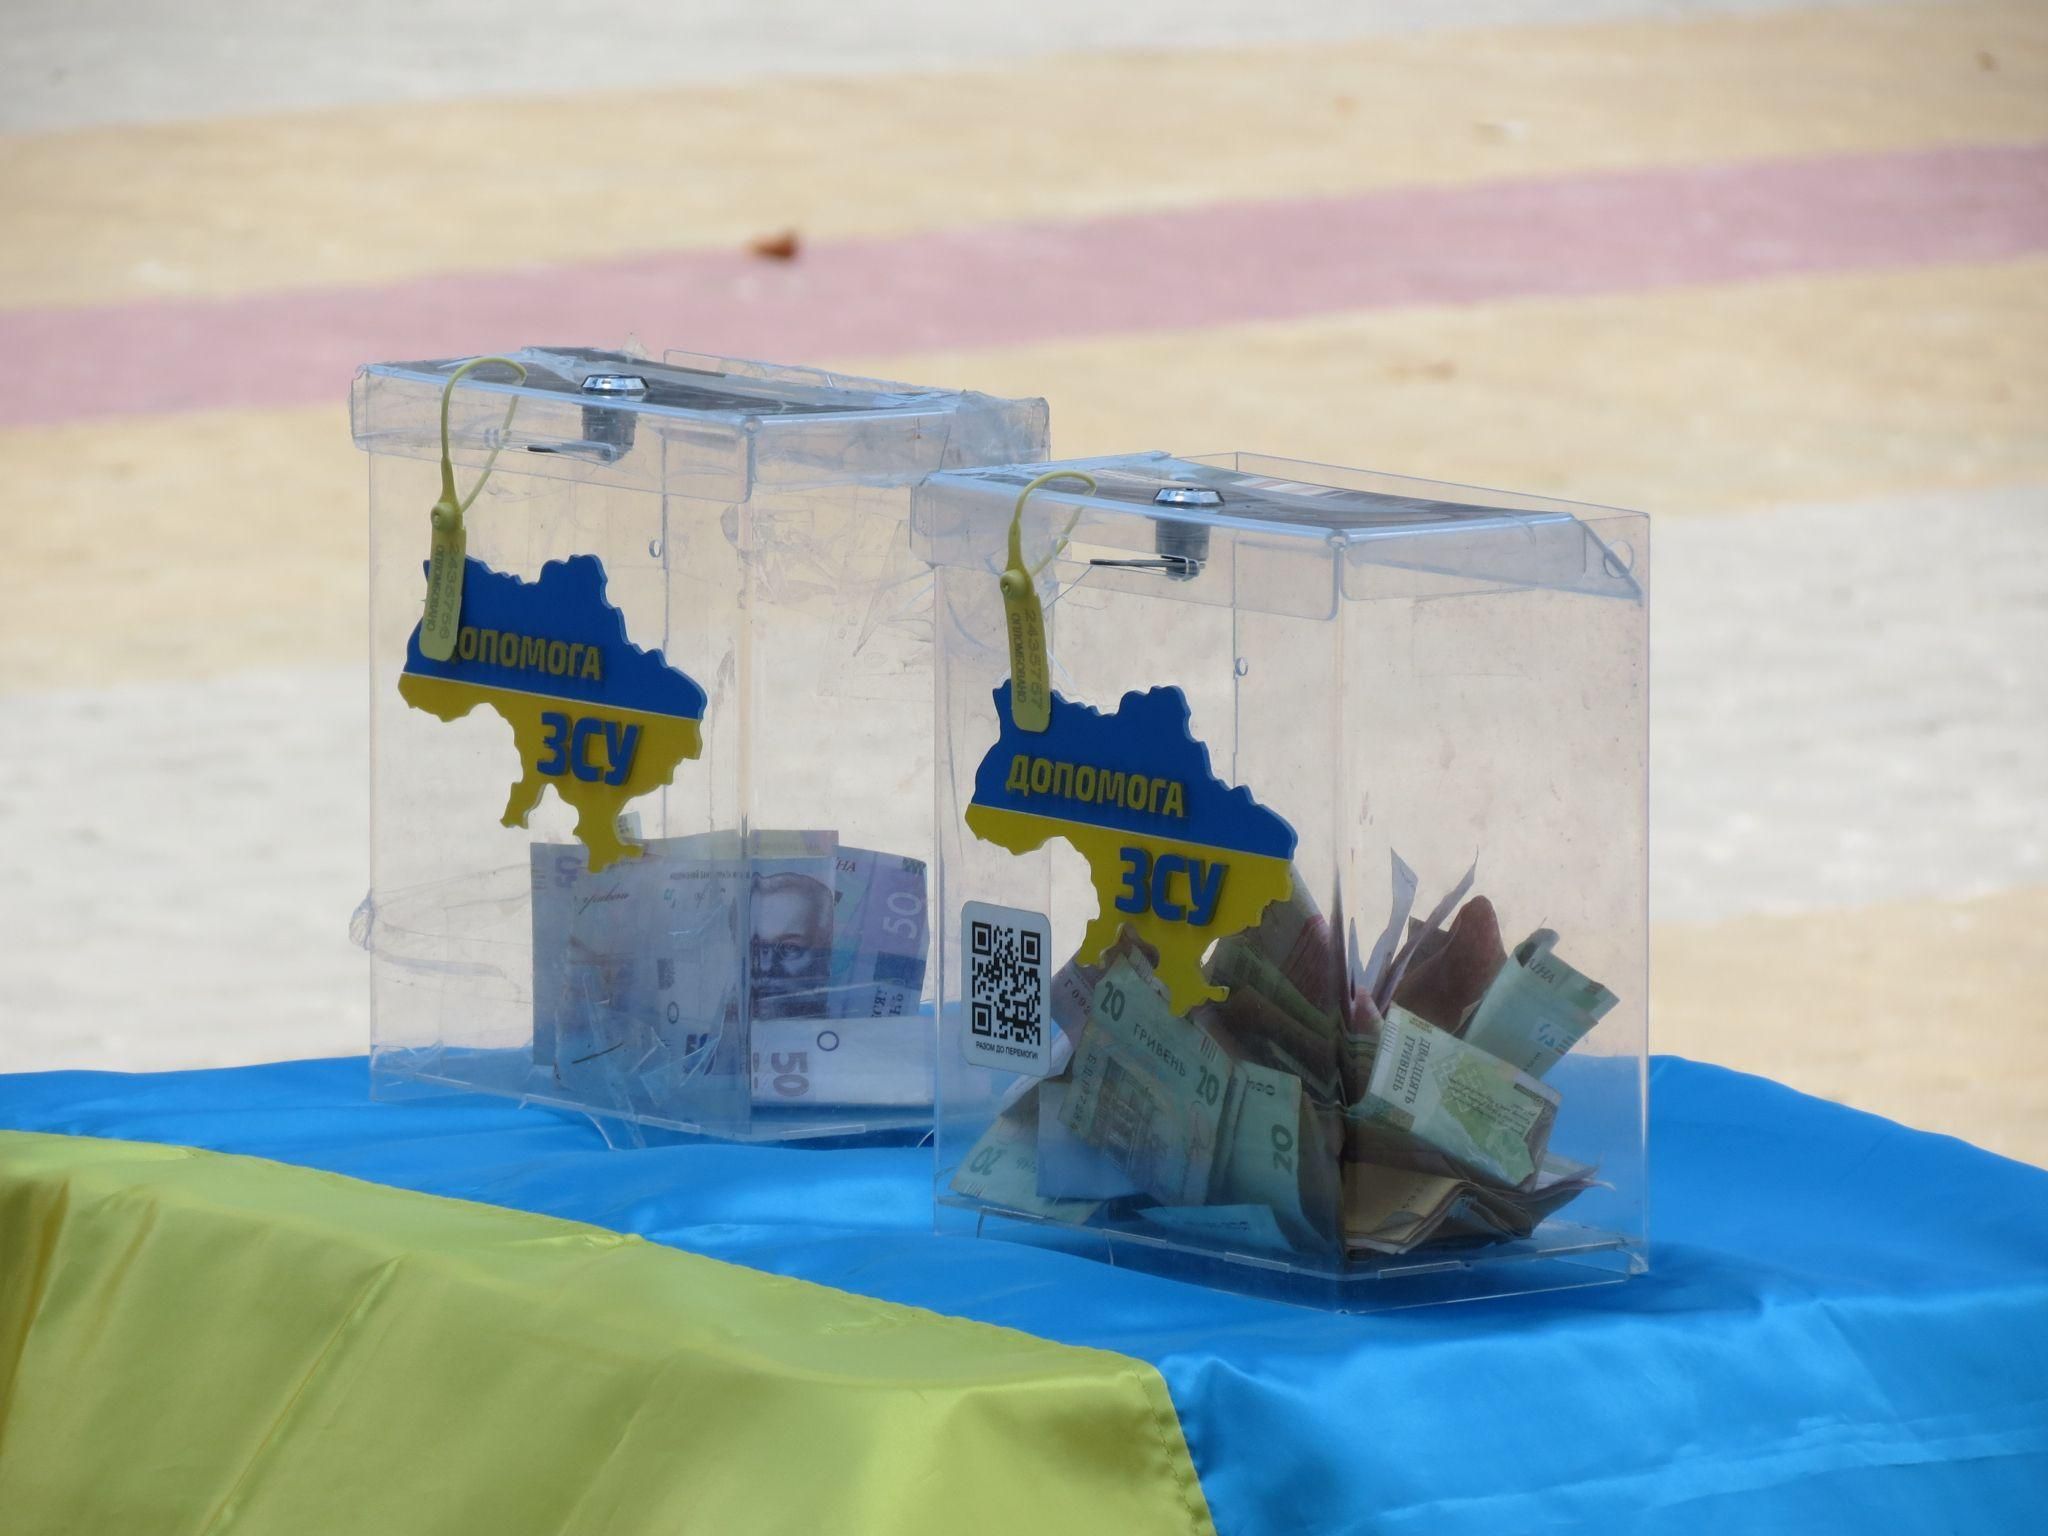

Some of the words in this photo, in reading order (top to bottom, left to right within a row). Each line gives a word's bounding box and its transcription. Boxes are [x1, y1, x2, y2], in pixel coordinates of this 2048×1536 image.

[454, 626, 601, 681] ОПОМОГА
[537, 712, 641, 787] ЗСУ
[1006, 754, 1184, 818] ДОПОМОГА
[1115, 847, 1228, 926] ЗСУ
[883, 891, 922, 940] 50
[1100, 980, 1127, 1023] 20
[771, 1051, 810, 1097] 50
[975, 1040, 995, 1052] РАЗОМ
[996, 1044, 1005, 1054] ДО
[1132, 1022, 1187, 1078] ГРИВЕНЬ
[1391, 1035, 1416, 1094] ГРИВЕНЬ
[1405, 1037, 1432, 1105] ДВАДЦЯТЬ
[1195, 1065, 1220, 1107] 20
[1271, 1123, 1294, 1176] 20
